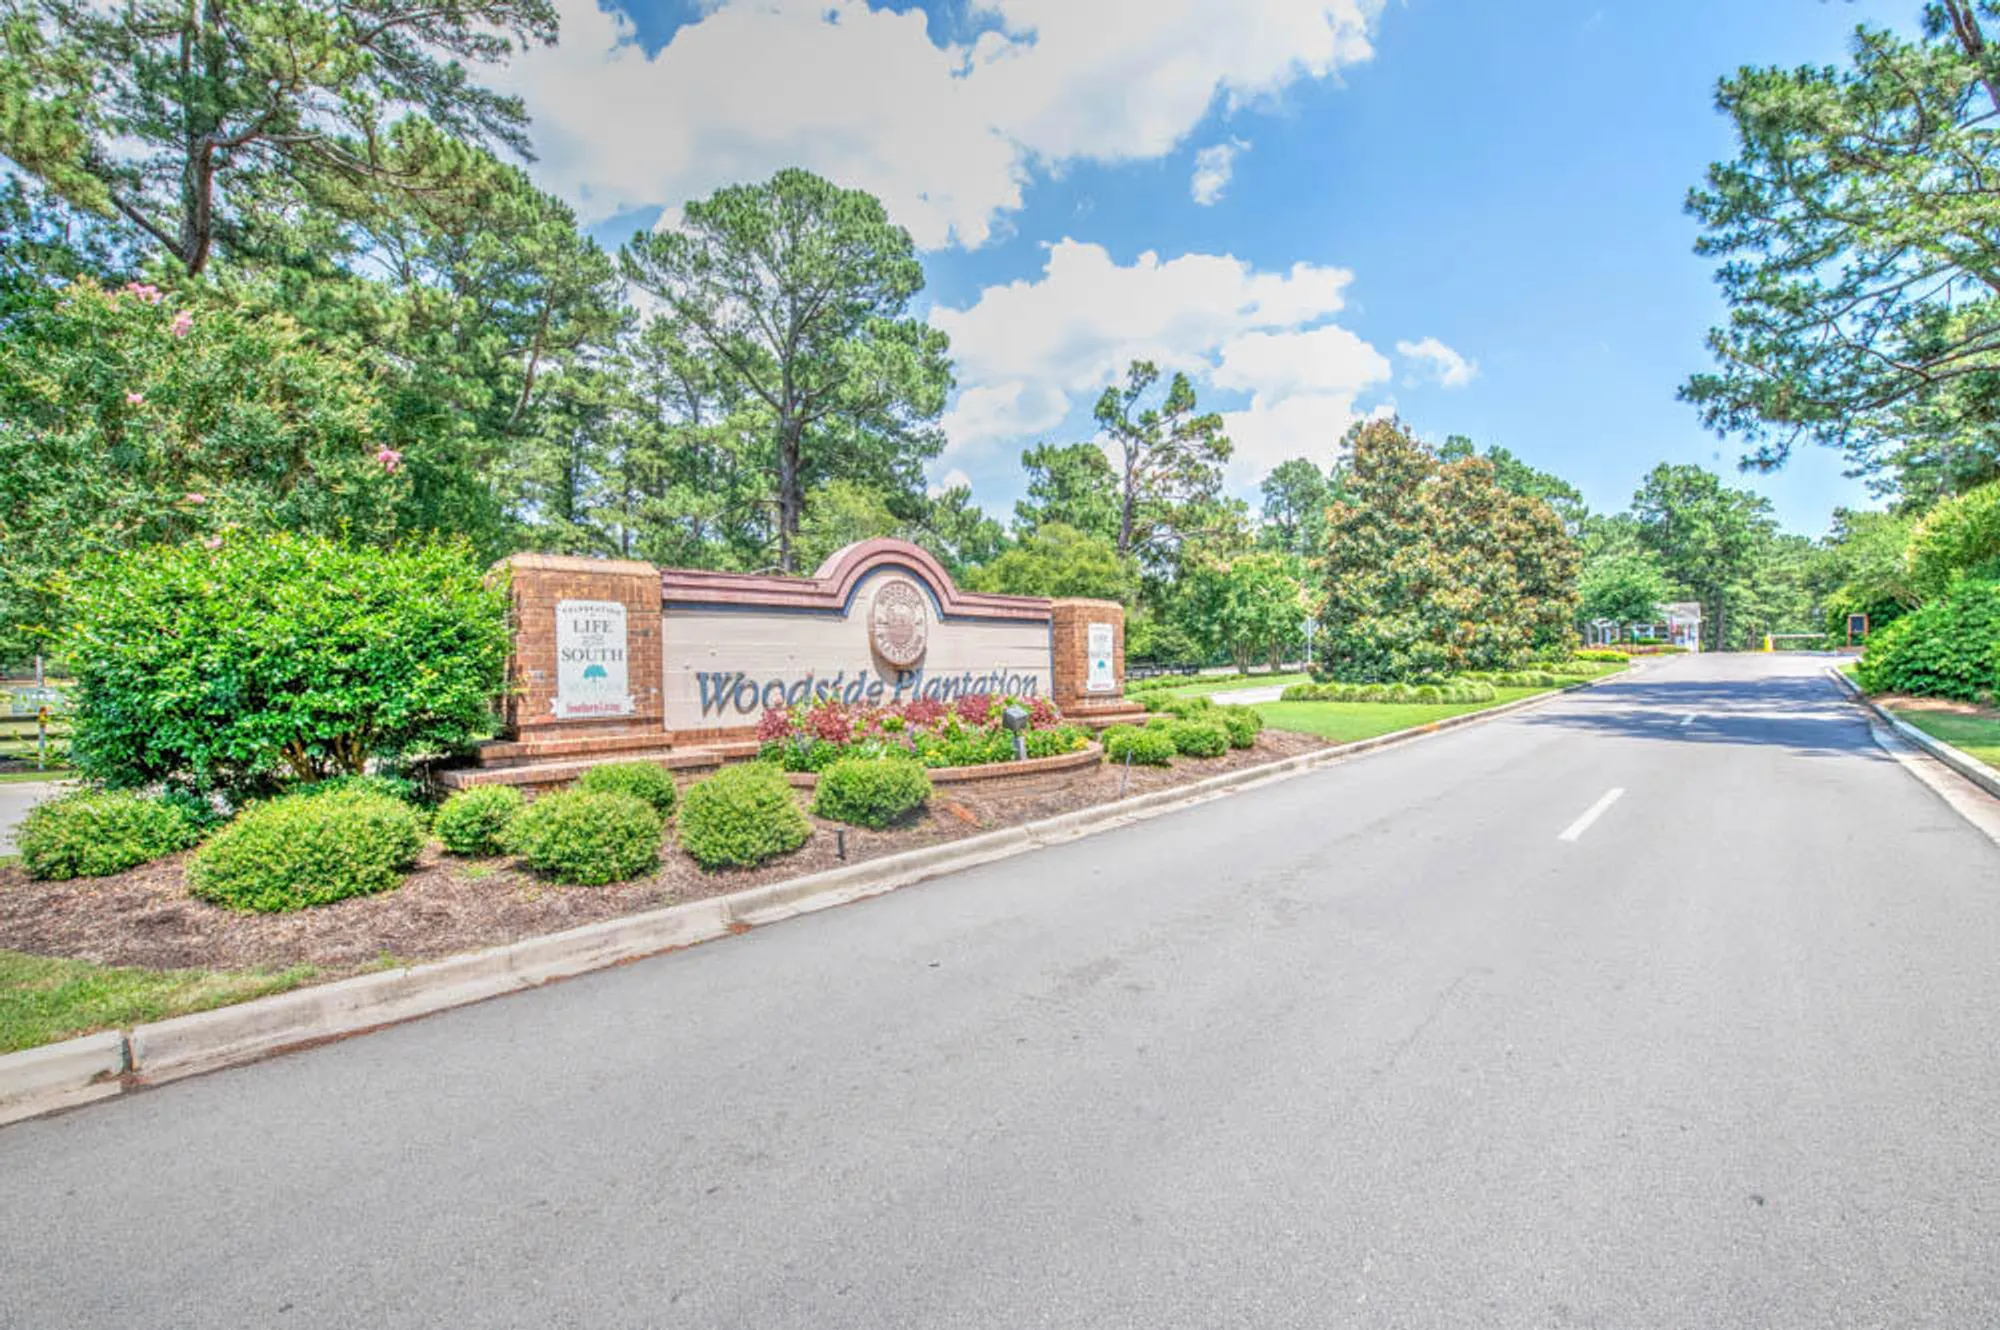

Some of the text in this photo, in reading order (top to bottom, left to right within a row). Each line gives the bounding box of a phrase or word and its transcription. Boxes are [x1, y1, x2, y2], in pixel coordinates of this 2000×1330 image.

[573, 619, 614, 633] LIFE
[561, 647, 623, 661] SOUTH
[695, 667, 1039, 719] Woodside Plantation
